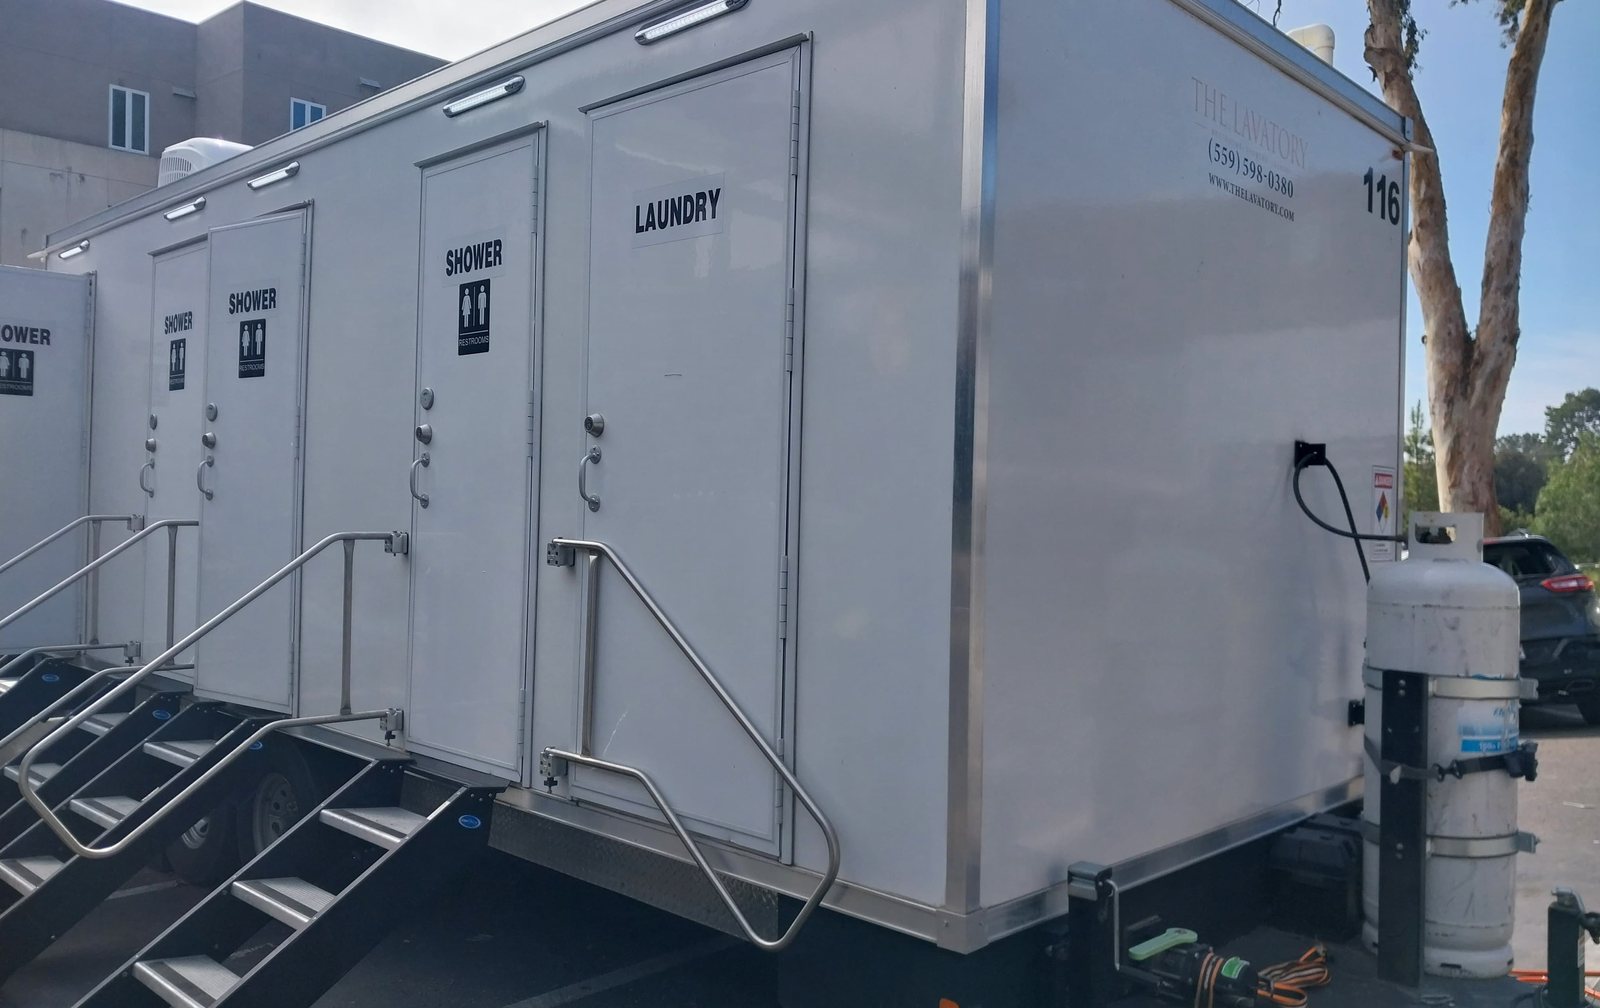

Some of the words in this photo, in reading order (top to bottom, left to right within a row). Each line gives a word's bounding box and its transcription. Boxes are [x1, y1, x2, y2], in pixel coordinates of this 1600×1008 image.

[1191, 76, 1227, 127] THE
[1235, 100, 1309, 169] LAVATORY
[635, 187, 721, 234] LAUNDRY
[1208, 172, 1295, 222] WWW.THELAVATORY.COM
[1363, 166, 1400, 225] 116
[446, 239, 502, 276] SHOWER
[229, 287, 277, 314] SHOWER
[164, 311, 193, 335] SHOWER
[459, 335, 489, 347] RESTROOMS
